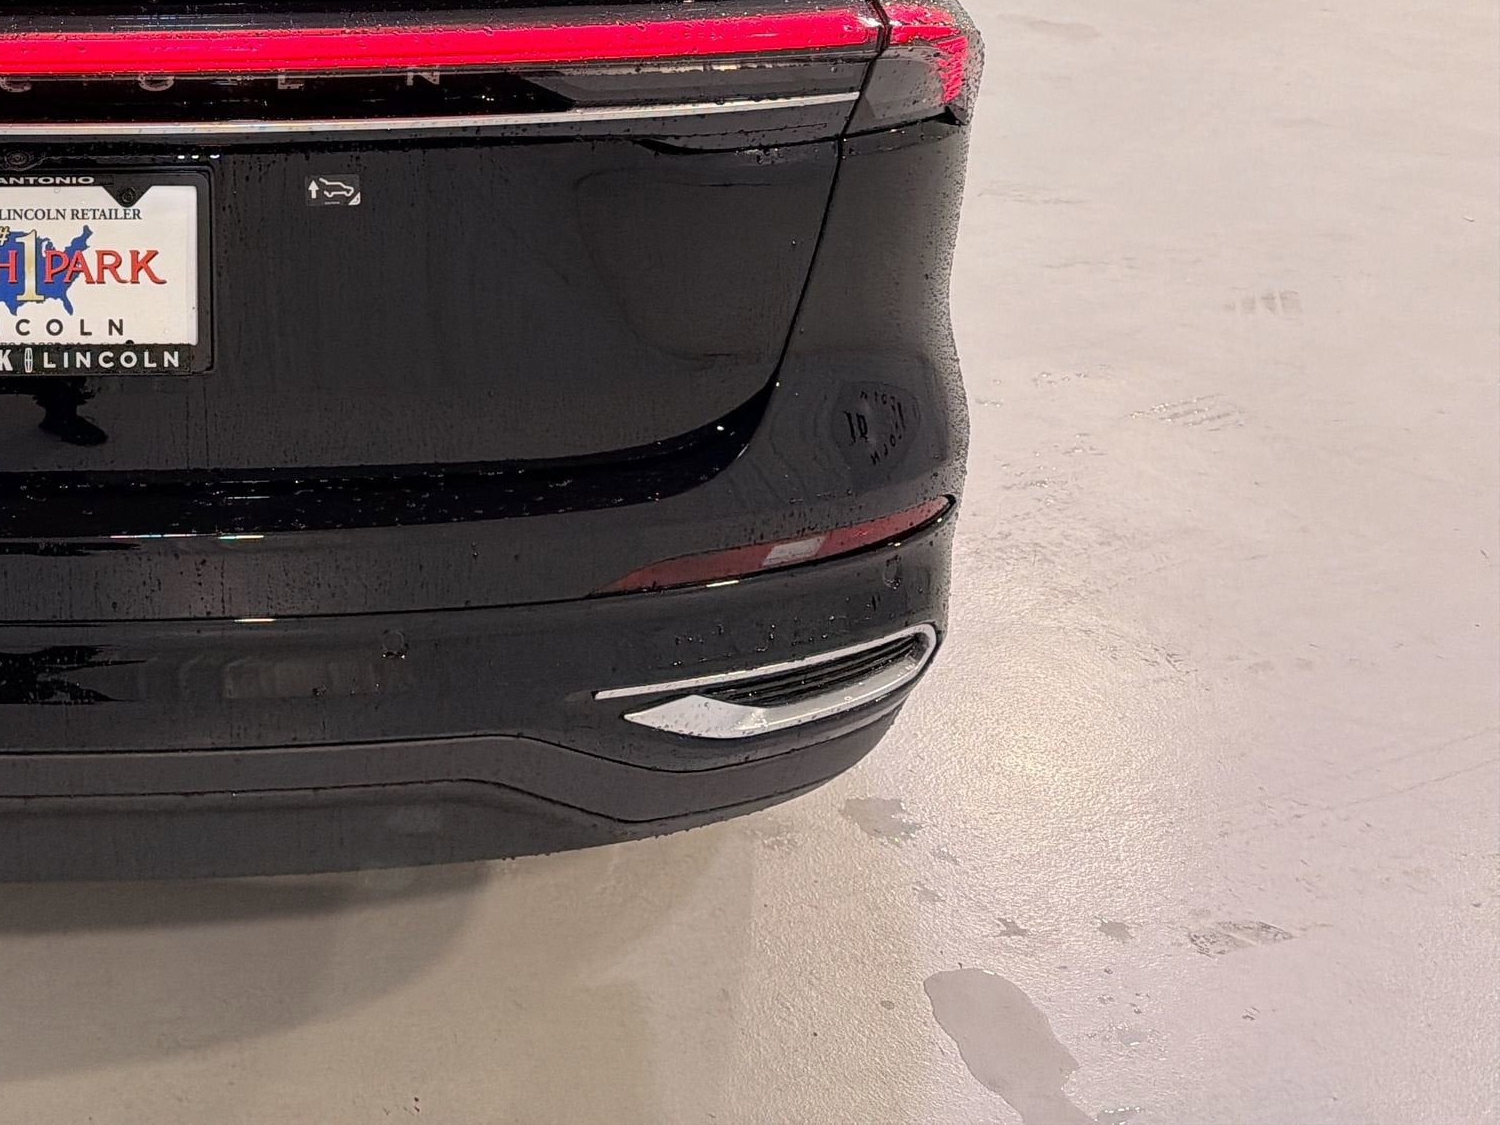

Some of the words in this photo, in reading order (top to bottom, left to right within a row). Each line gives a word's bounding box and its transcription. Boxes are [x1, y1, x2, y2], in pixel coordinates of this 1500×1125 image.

[70, 208, 143, 221] RETAILER
[44, 249, 168, 286] PARK
[43, 350, 180, 370] LINCOLN
